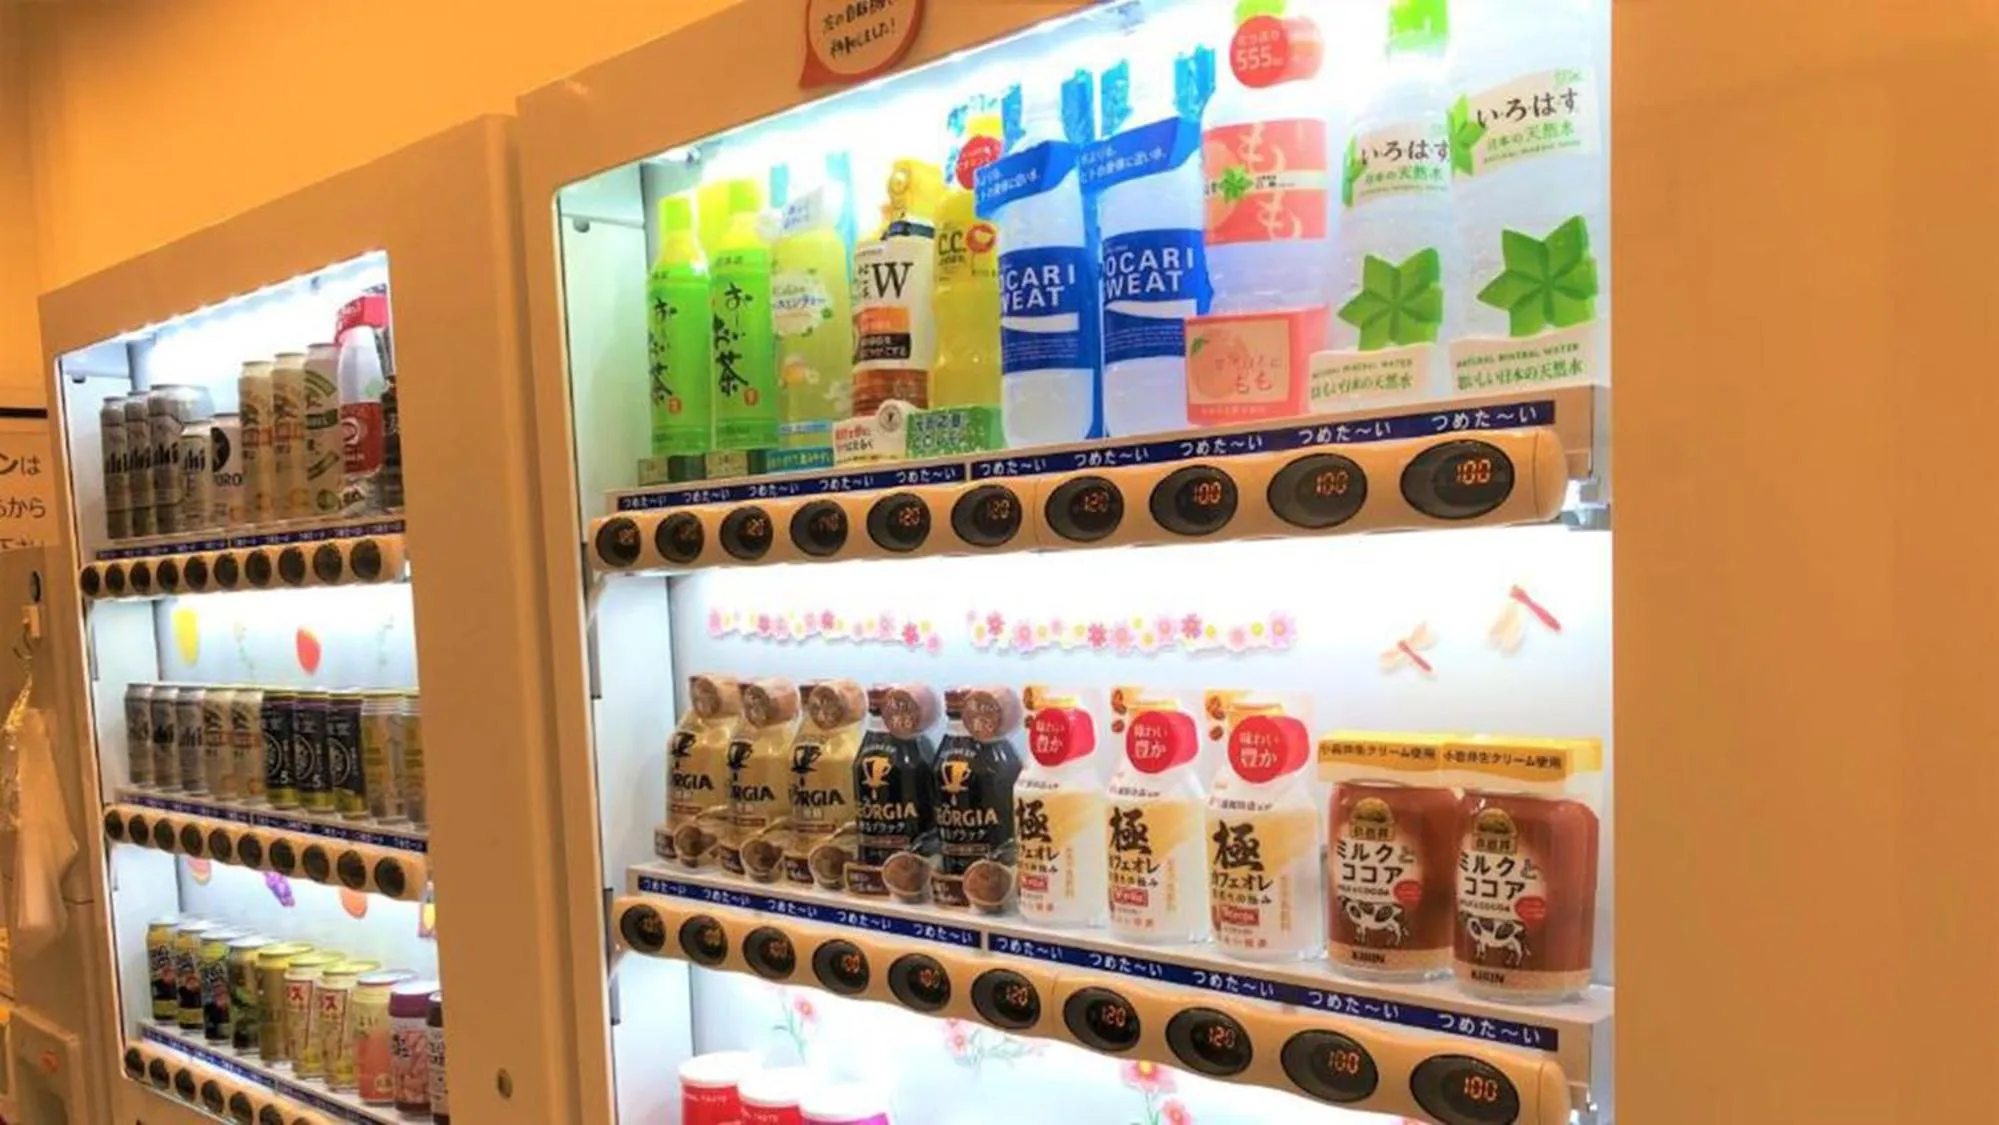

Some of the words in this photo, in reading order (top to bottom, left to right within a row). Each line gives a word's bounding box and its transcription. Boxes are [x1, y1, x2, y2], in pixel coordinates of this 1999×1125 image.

[1315, 471, 1349, 495] 100
[1456, 459, 1493, 485] 100
[1016, 797, 1052, 842] 極
[1109, 806, 1152, 855] 極
[1213, 819, 1265, 872] 極
[1336, 840, 1415, 864] ミルクと
[1342, 863, 1404, 885] ココア
[1459, 851, 1538, 880] ミルクと
[1464, 877, 1527, 900] ココア
[1207, 1026, 1236, 1049] 120
[1328, 1050, 1360, 1075] 100
[1463, 1075, 1499, 1102] 100
